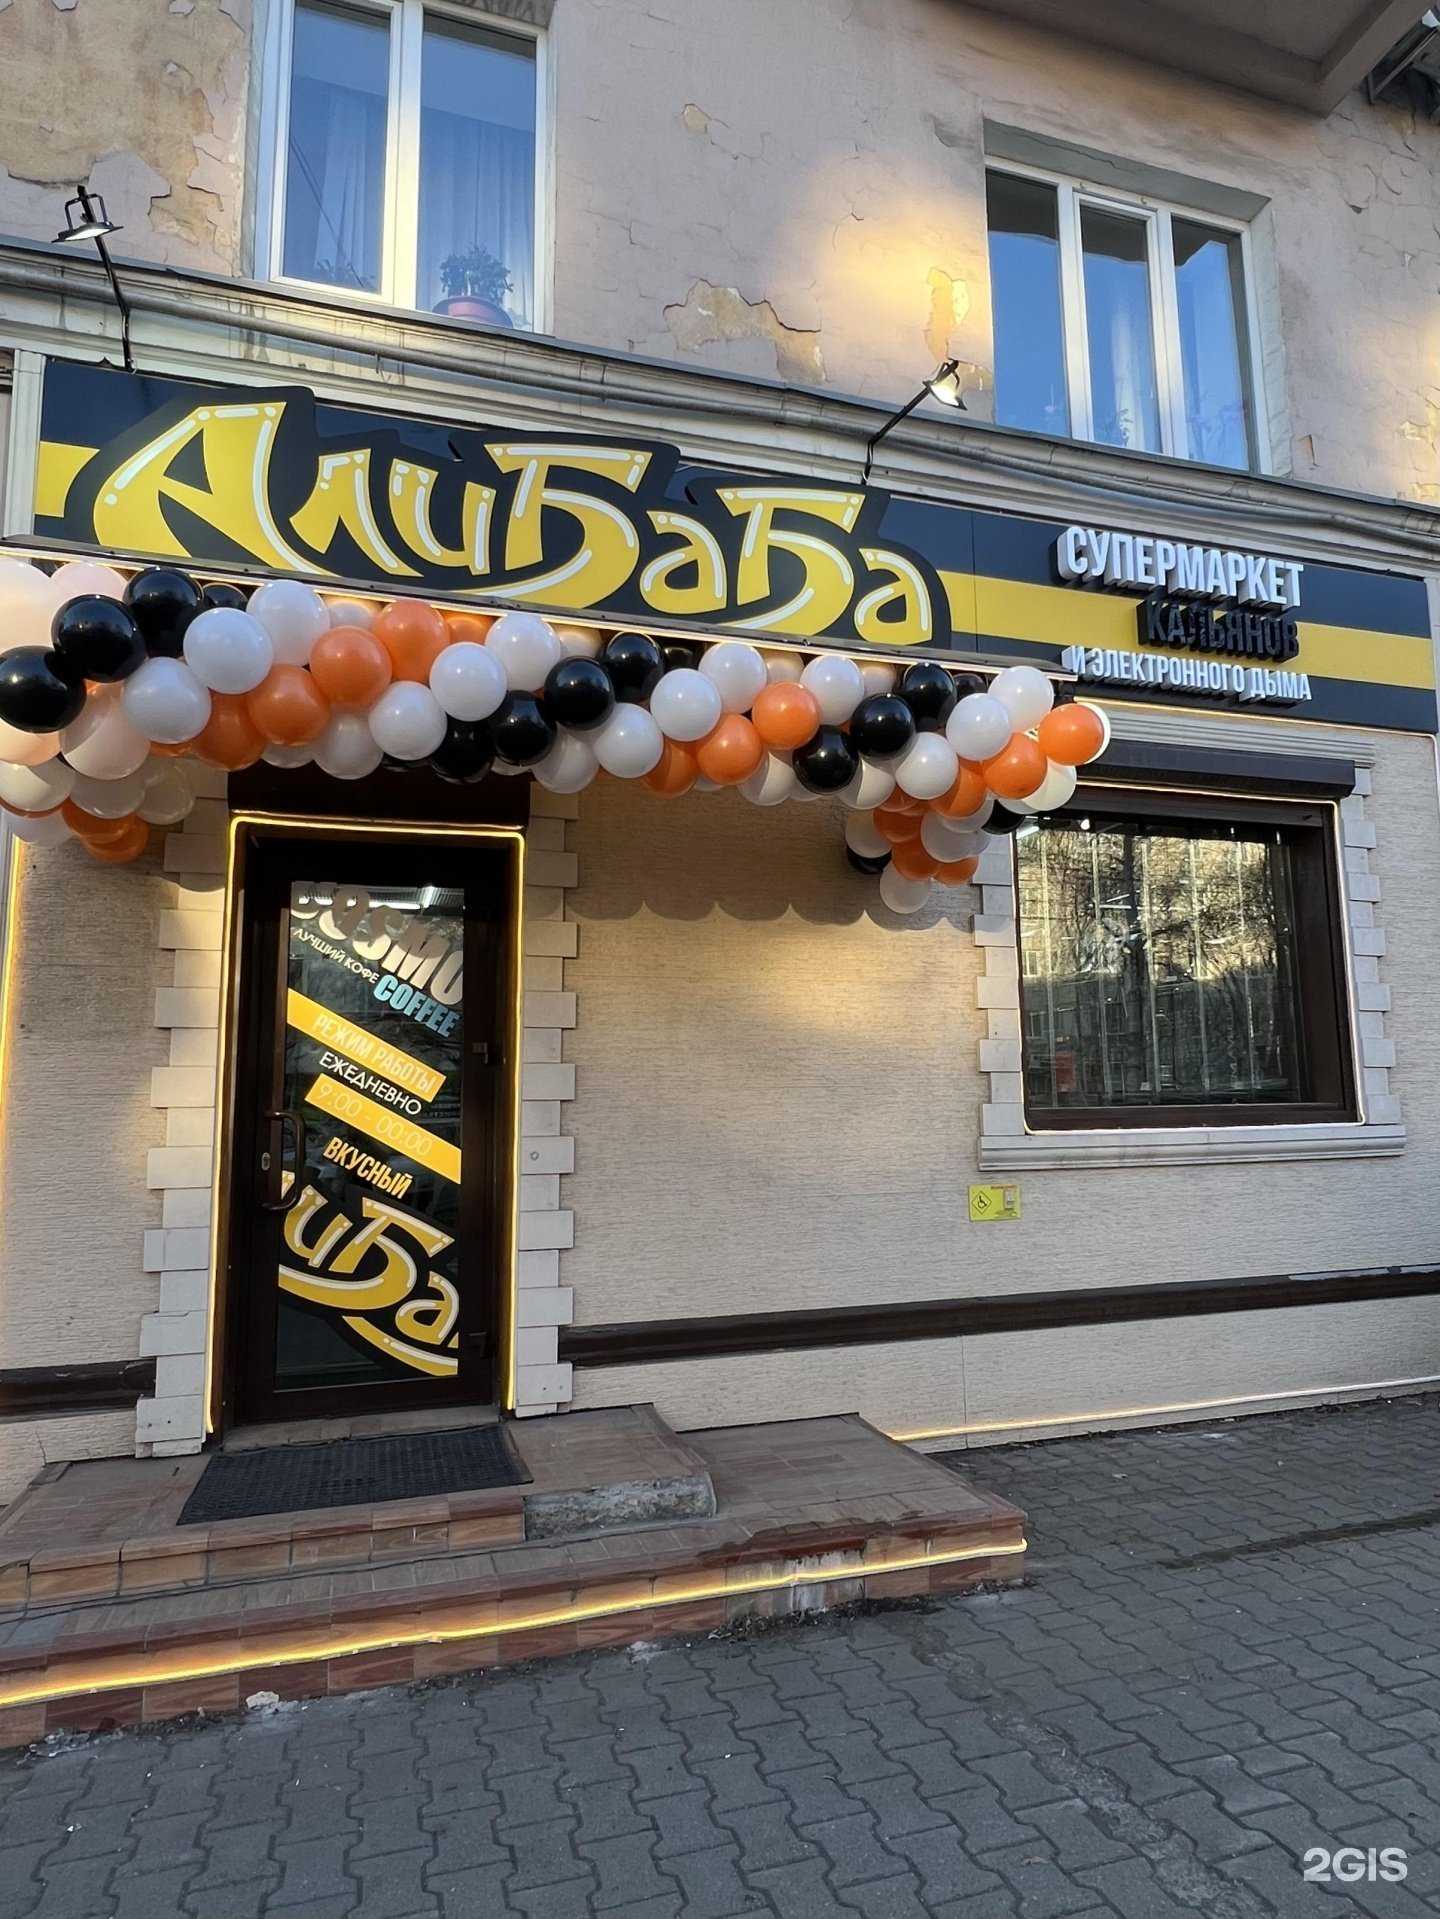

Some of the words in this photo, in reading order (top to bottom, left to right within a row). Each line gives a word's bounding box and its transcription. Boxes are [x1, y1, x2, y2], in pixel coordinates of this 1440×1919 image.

[1060, 526, 1304, 608] СУПЕРМАРКЕТ
[1142, 601, 1299, 661] КАЛЬЯНОВ
[1068, 645, 1086, 675] И
[1088, 648, 1245, 693] ЭЛЕКТРОННОГО
[1244, 668, 1312, 701] ДЫМА
[294, 928, 346, 963] ЛУЧШИЙ
[344, 957, 380, 984] КОФЕ
[373, 974, 460, 1038] COFFEE
[312, 1013, 374, 1059] РЕЖИМ
[372, 1046, 437, 1093] РАБОТЫ
[319, 1051, 422, 1116] ЕЖЕДНЕВНО
[323, 1136, 414, 1199] ВКУСНЫЙ
